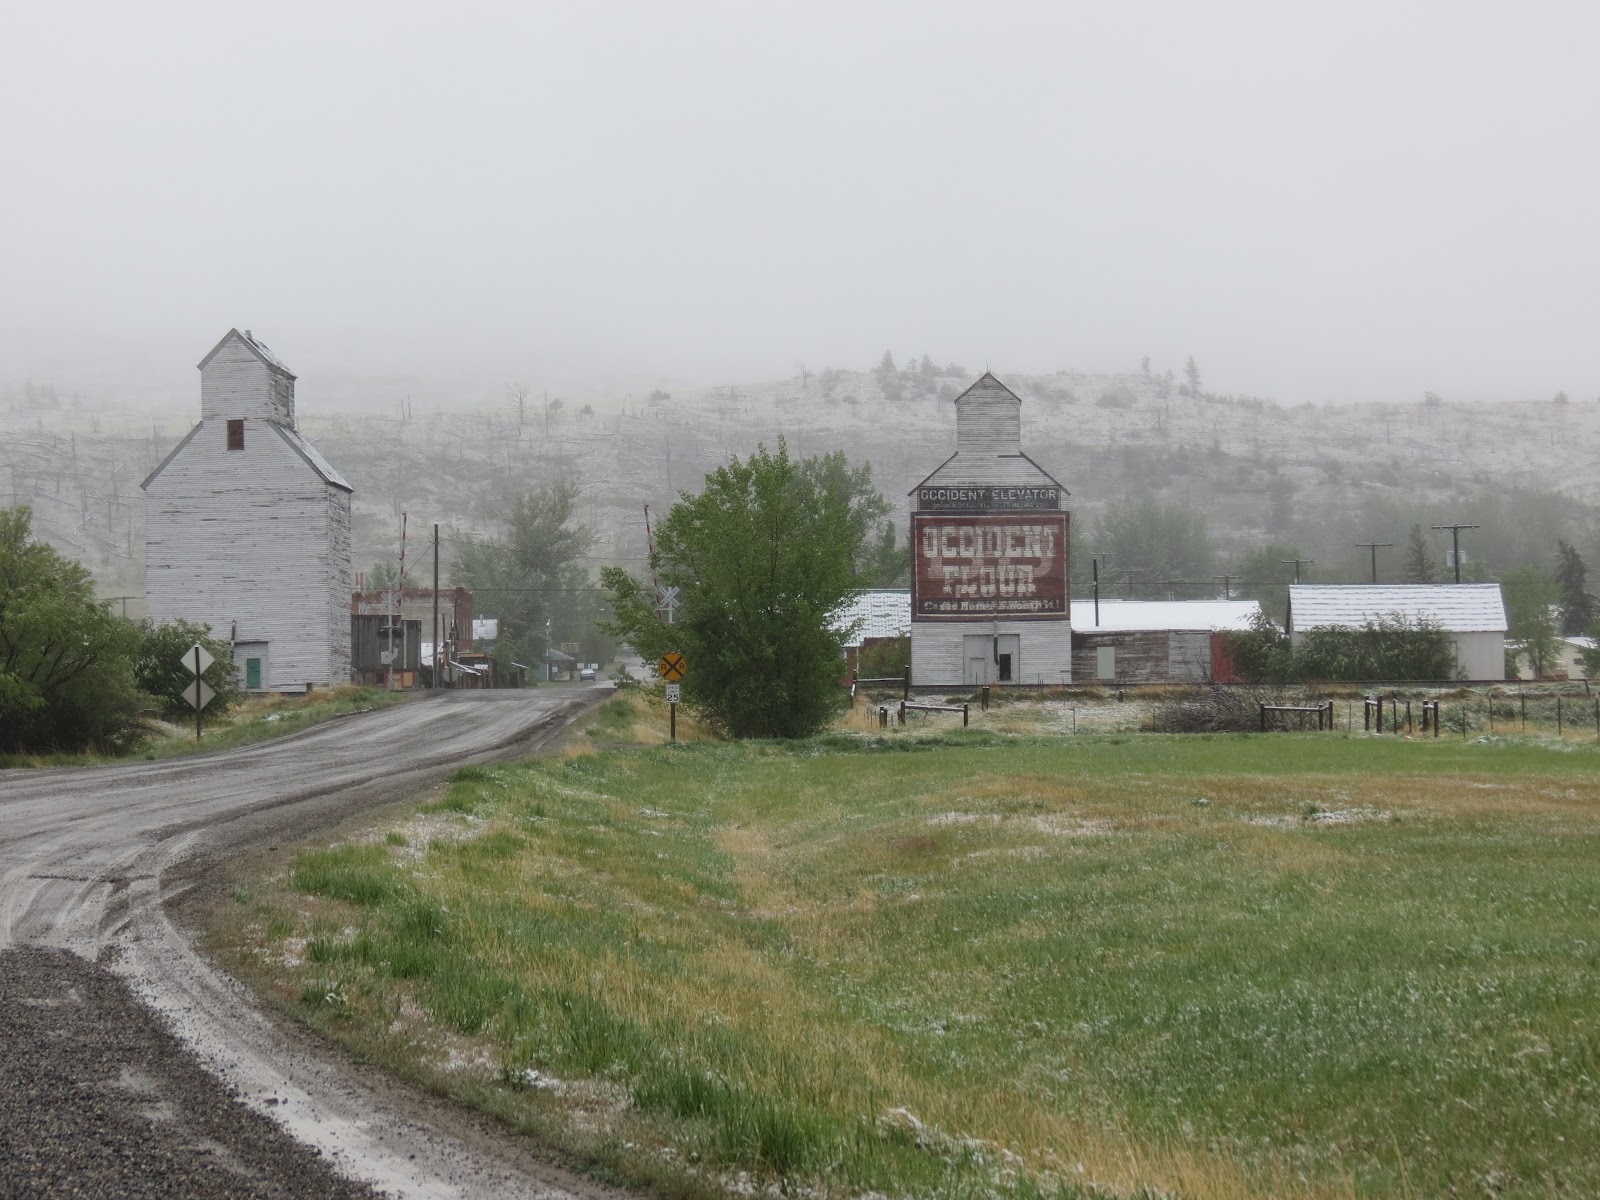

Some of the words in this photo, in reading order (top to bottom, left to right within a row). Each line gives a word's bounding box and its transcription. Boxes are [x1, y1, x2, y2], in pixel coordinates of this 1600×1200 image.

[920, 489, 985, 500] OCCIDENT
[992, 489, 1057, 500] ELEVATOR
[922, 525, 1059, 557] OCCIDENT
[942, 565, 1037, 598] FLOUR
[661, 663, 667, 671] R
[679, 662, 685, 670] R
[667, 693, 679, 701] 25
